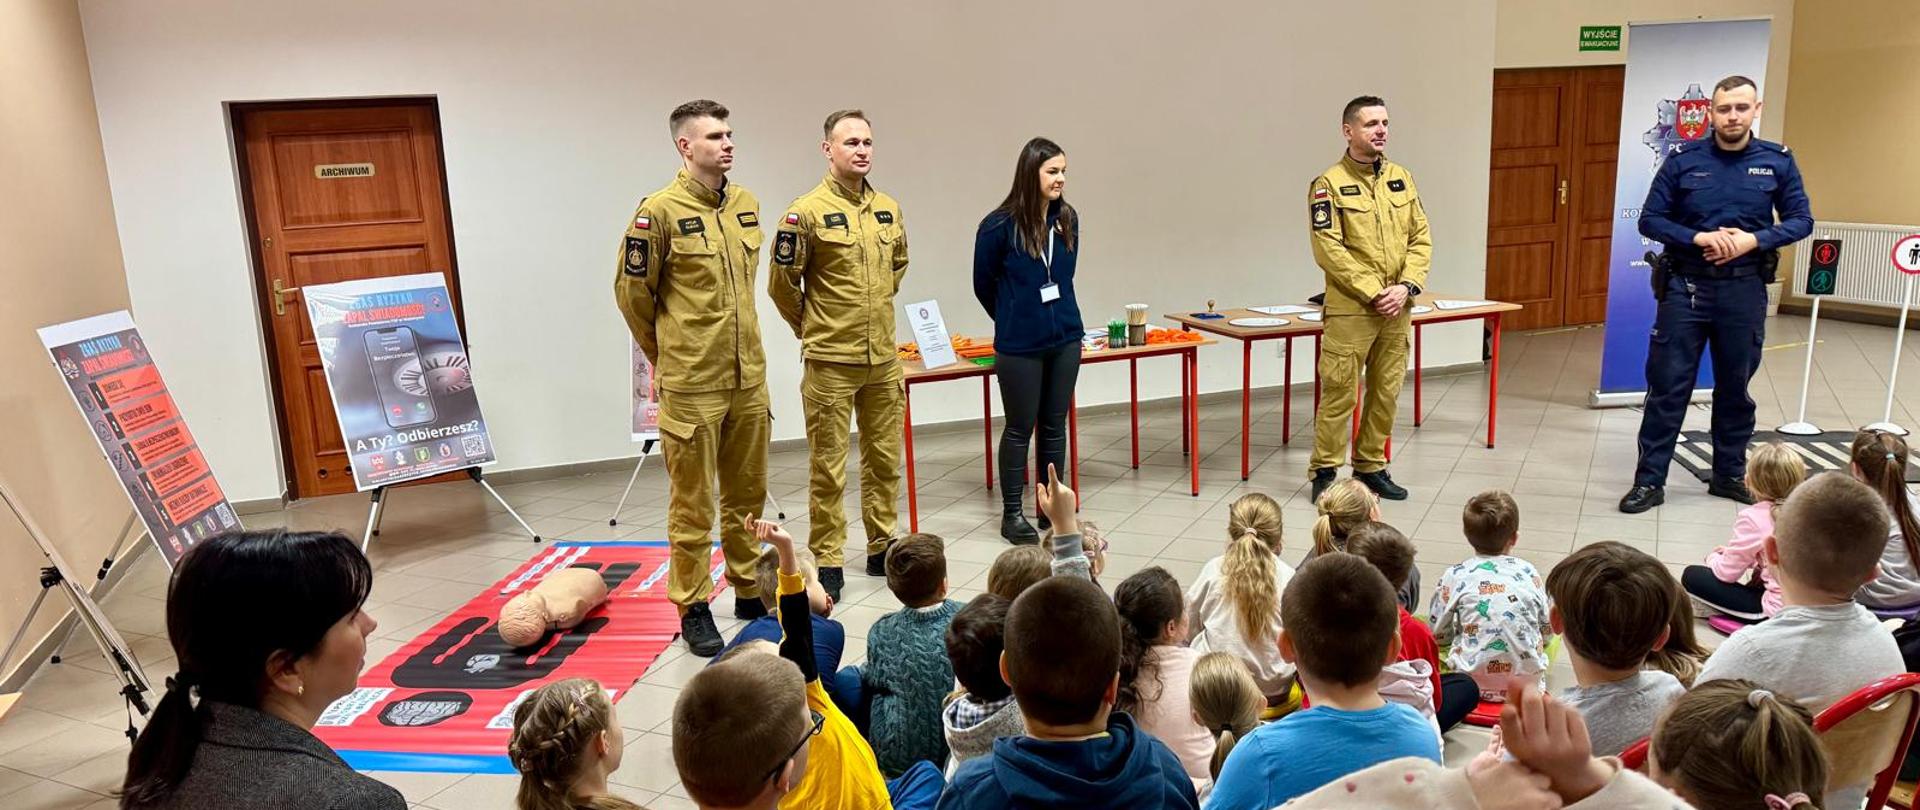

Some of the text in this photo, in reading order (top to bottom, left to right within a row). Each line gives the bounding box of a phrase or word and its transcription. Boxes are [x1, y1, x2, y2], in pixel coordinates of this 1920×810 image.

[1583, 29, 1618, 39] WYJŚCIE
[321, 166, 370, 177] ARCHIWUM
[1748, 167, 1774, 176] POLICJA
[356, 420, 479, 452] A Ty? Odbierzesz?
